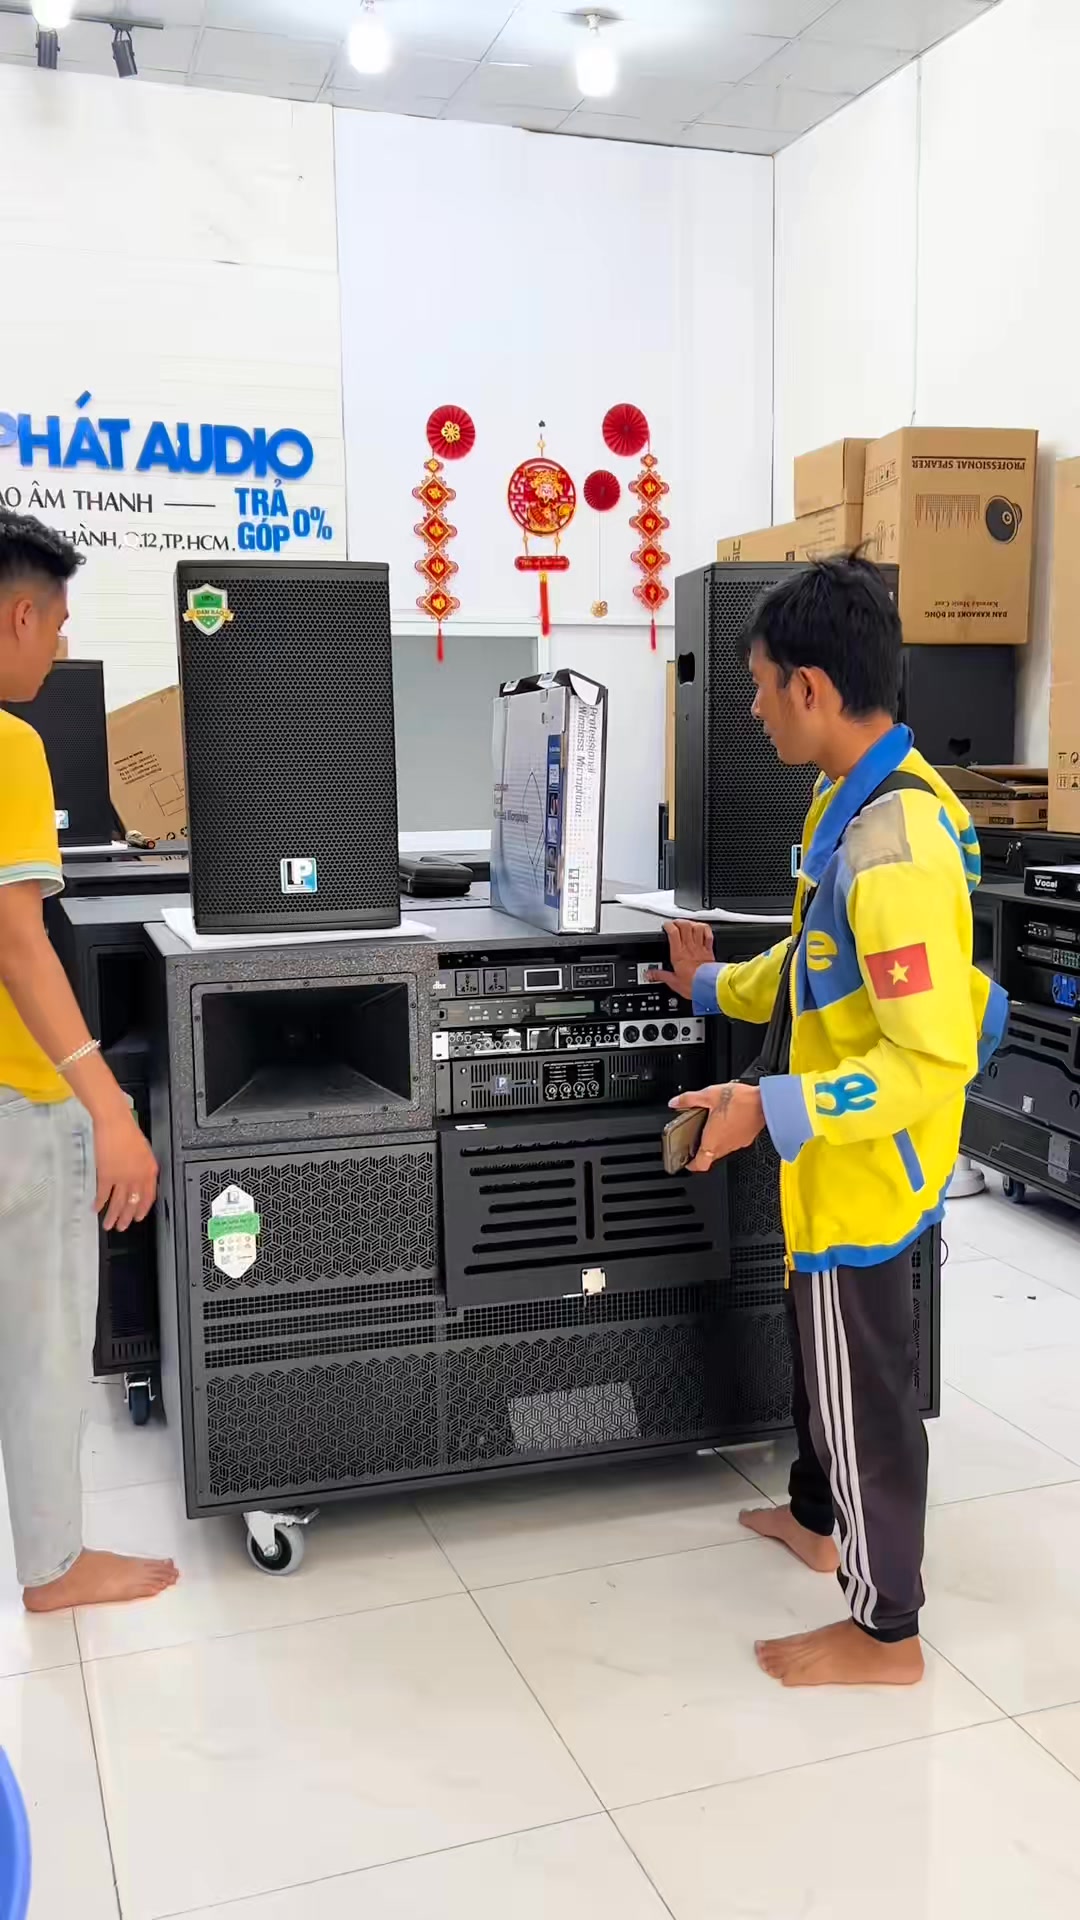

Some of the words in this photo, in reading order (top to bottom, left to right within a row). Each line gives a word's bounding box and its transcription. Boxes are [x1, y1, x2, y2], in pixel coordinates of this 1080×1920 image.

[136, 421, 313, 479] AUDIO
[912, 460, 954, 469] SPEAKER
[957, 460, 1025, 471] PROFESSIONAL
[28, 480, 66, 509] ÂM
[73, 489, 153, 513] THANH
[234, 478, 289, 516] TRẢ
[237, 518, 290, 553] GÓP
[293, 506, 333, 540] 0%
[576, 705, 588, 752] Wireless
[586, 706, 599, 774] Professional
